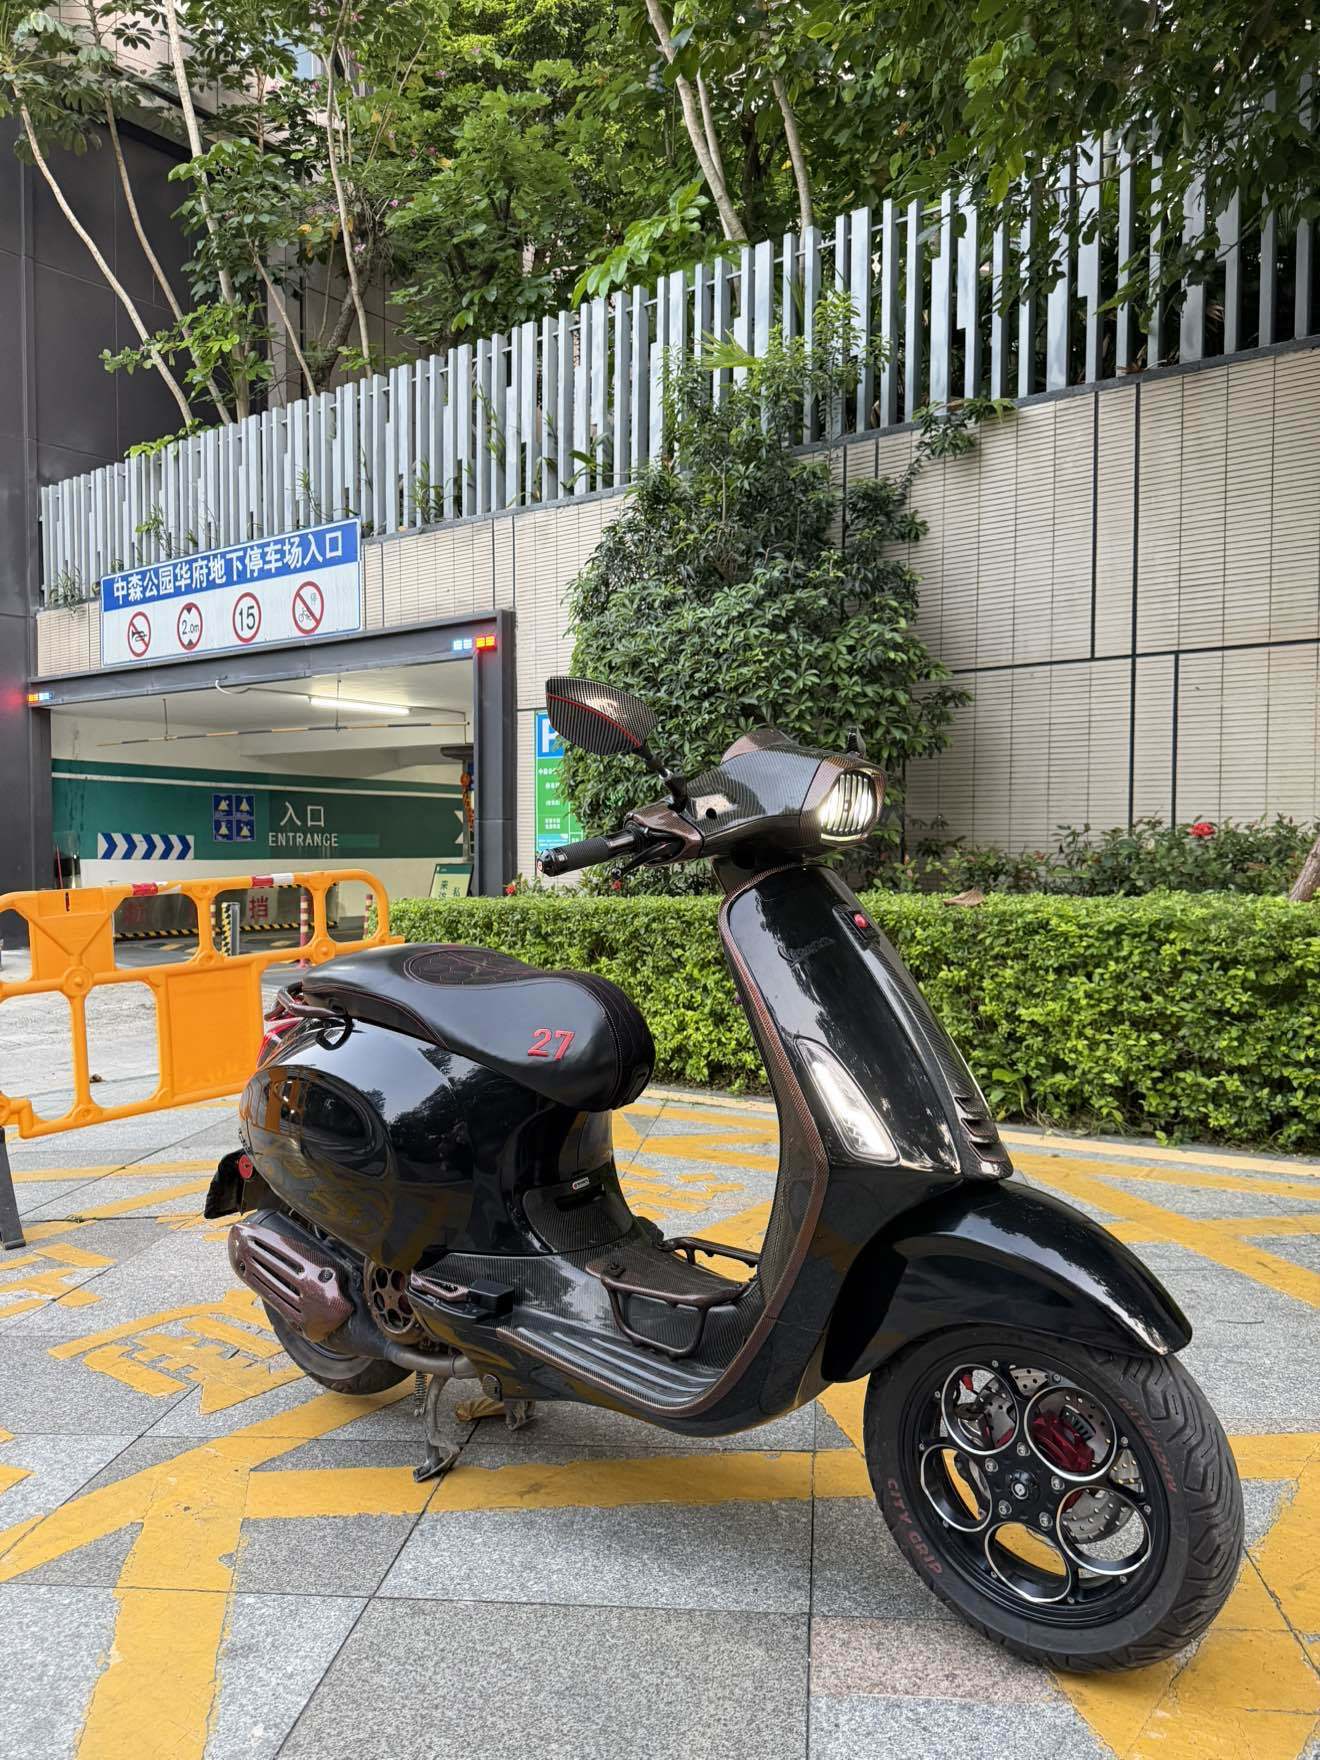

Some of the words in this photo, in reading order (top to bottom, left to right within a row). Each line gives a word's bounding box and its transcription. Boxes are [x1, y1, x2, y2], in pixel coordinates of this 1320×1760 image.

[113, 531, 343, 605] 中森公园华府地下停车场入口
[239, 605, 256, 632] 15
[280, 801, 325, 828] 入口
[268, 832, 339, 848] ENTRANCE
[527, 1027, 576, 1061] 27
[907, 1530, 943, 1575] GRIP
